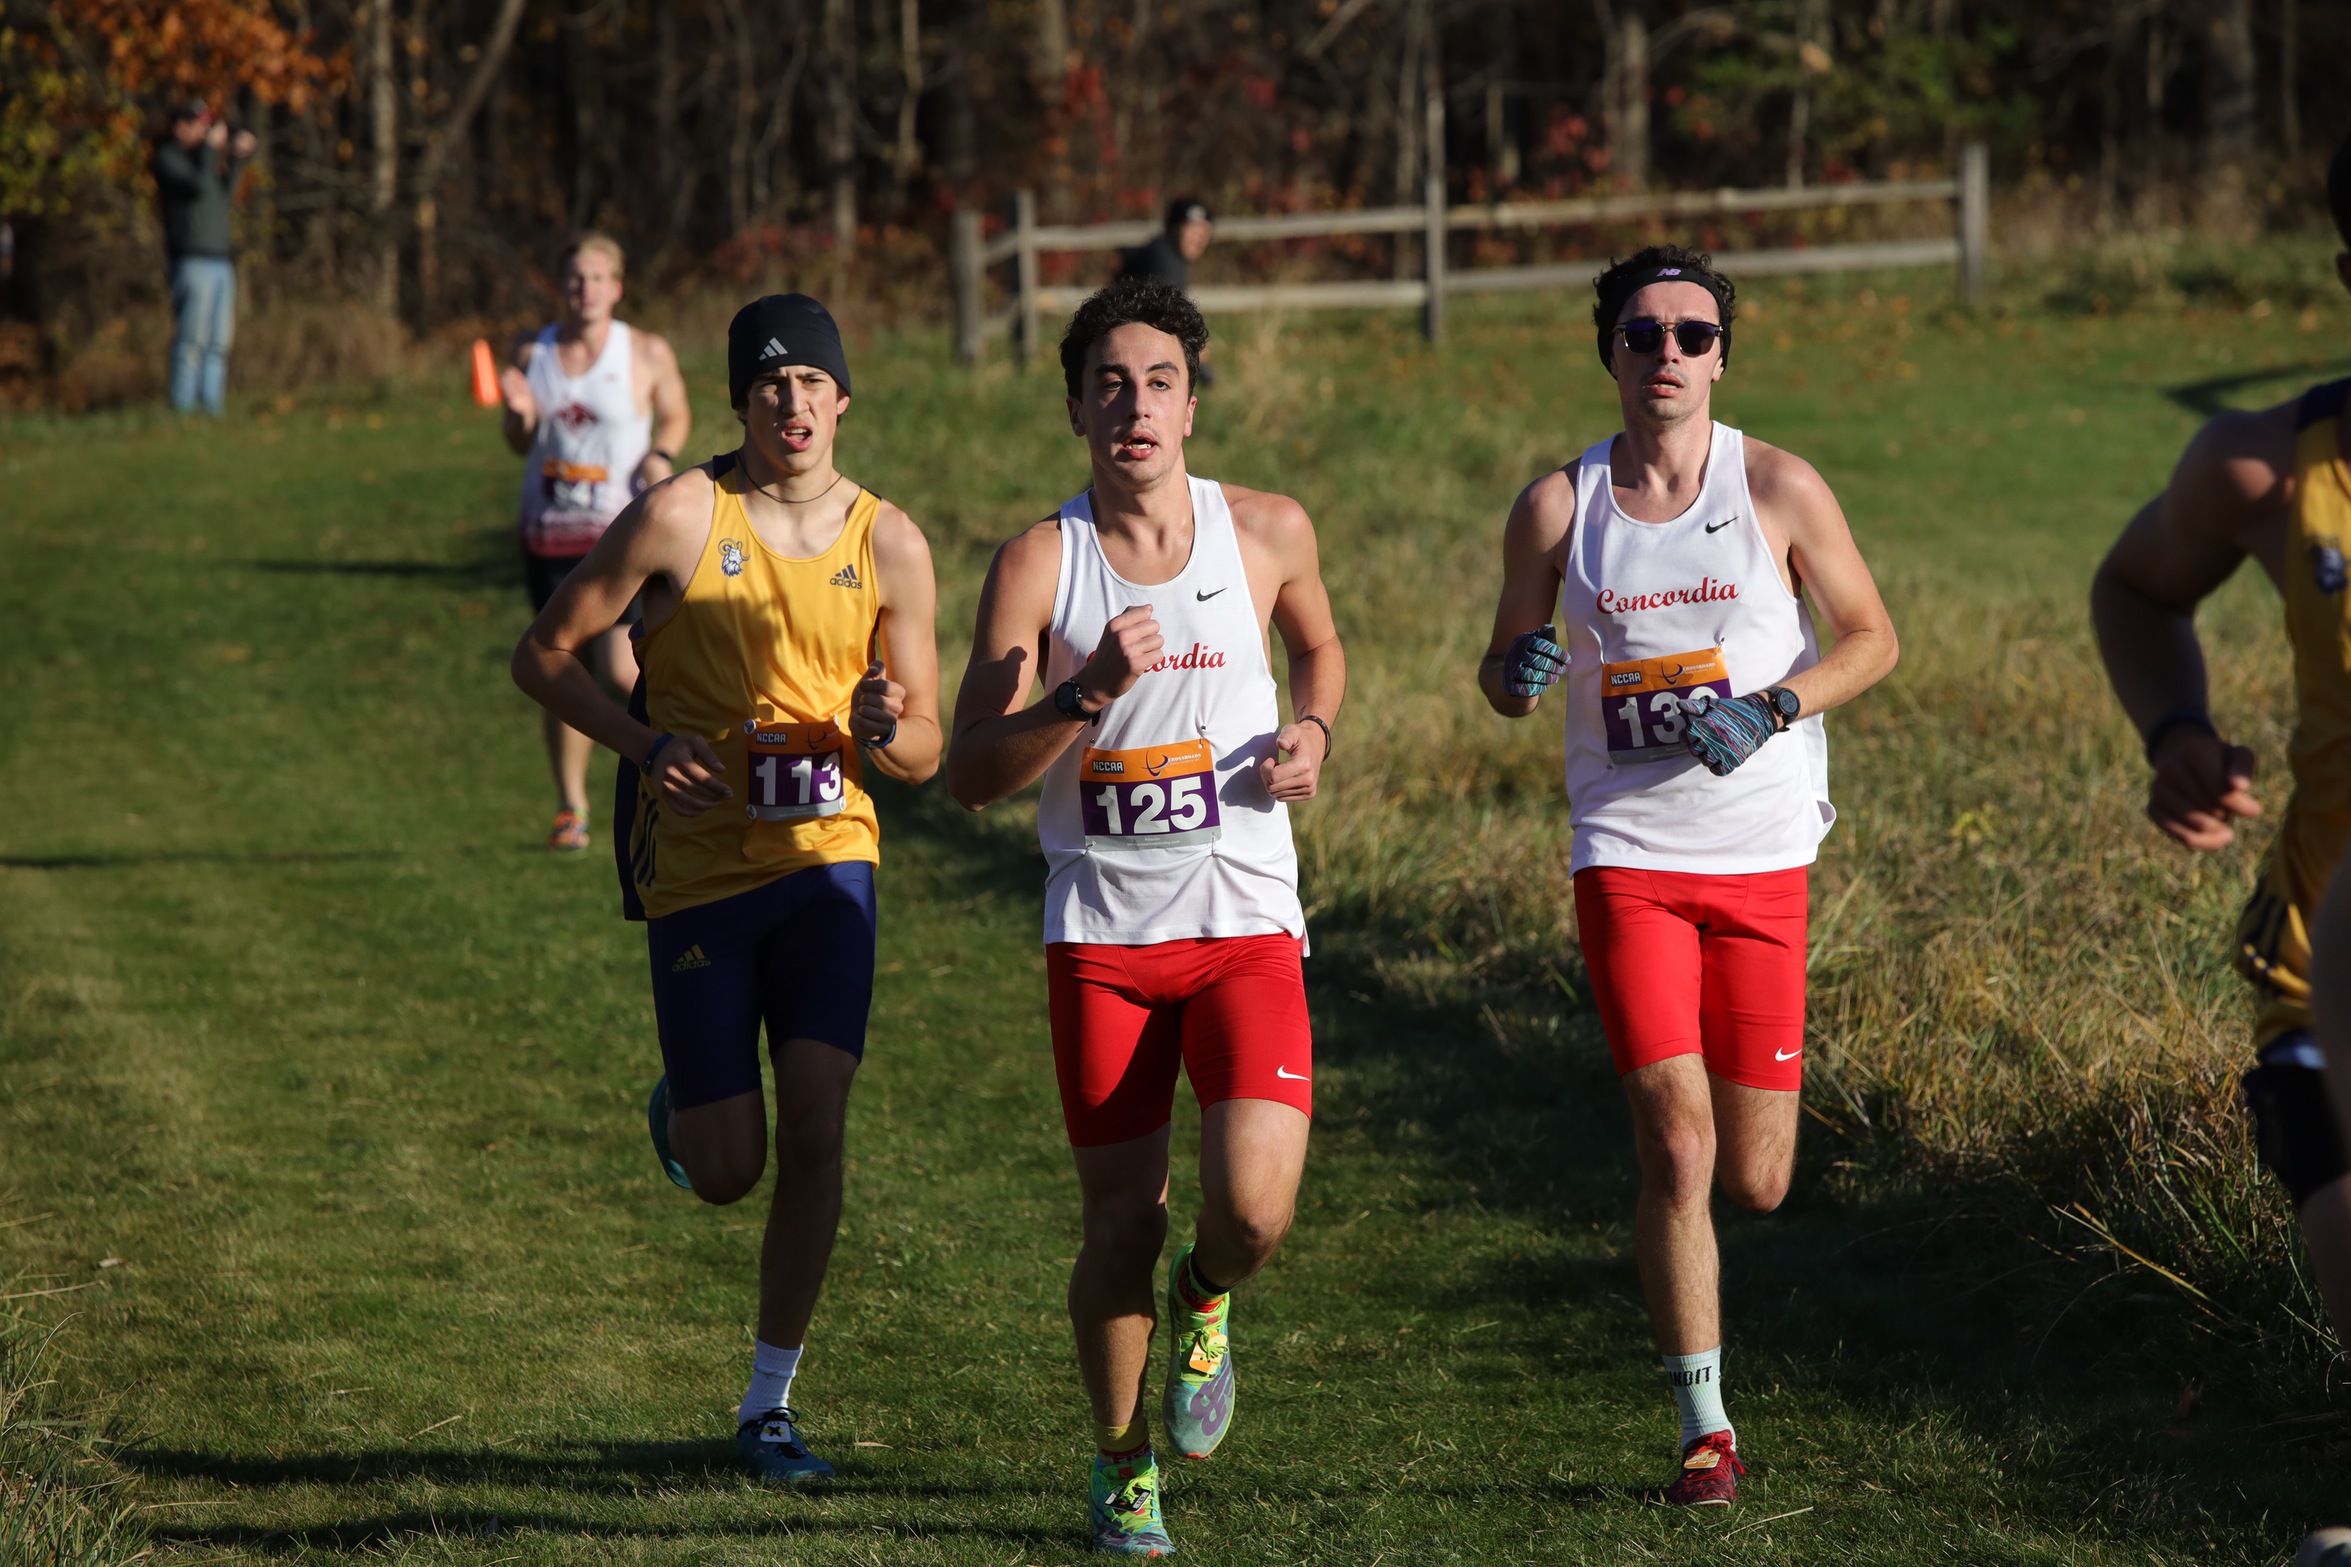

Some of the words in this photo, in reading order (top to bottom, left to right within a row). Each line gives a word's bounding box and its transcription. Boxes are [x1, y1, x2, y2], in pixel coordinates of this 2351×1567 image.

[1596, 576, 1740, 615] Concordia
[1611, 672, 1642, 685] NCCAA
[1618, 686, 1720, 748] 13
[757, 733, 787, 744] NCCAA
[756, 752, 842, 806] 113
[1093, 760, 1124, 772] NCCAA
[1096, 776, 1207, 835] 125
[671, 960, 711, 973] adidas
